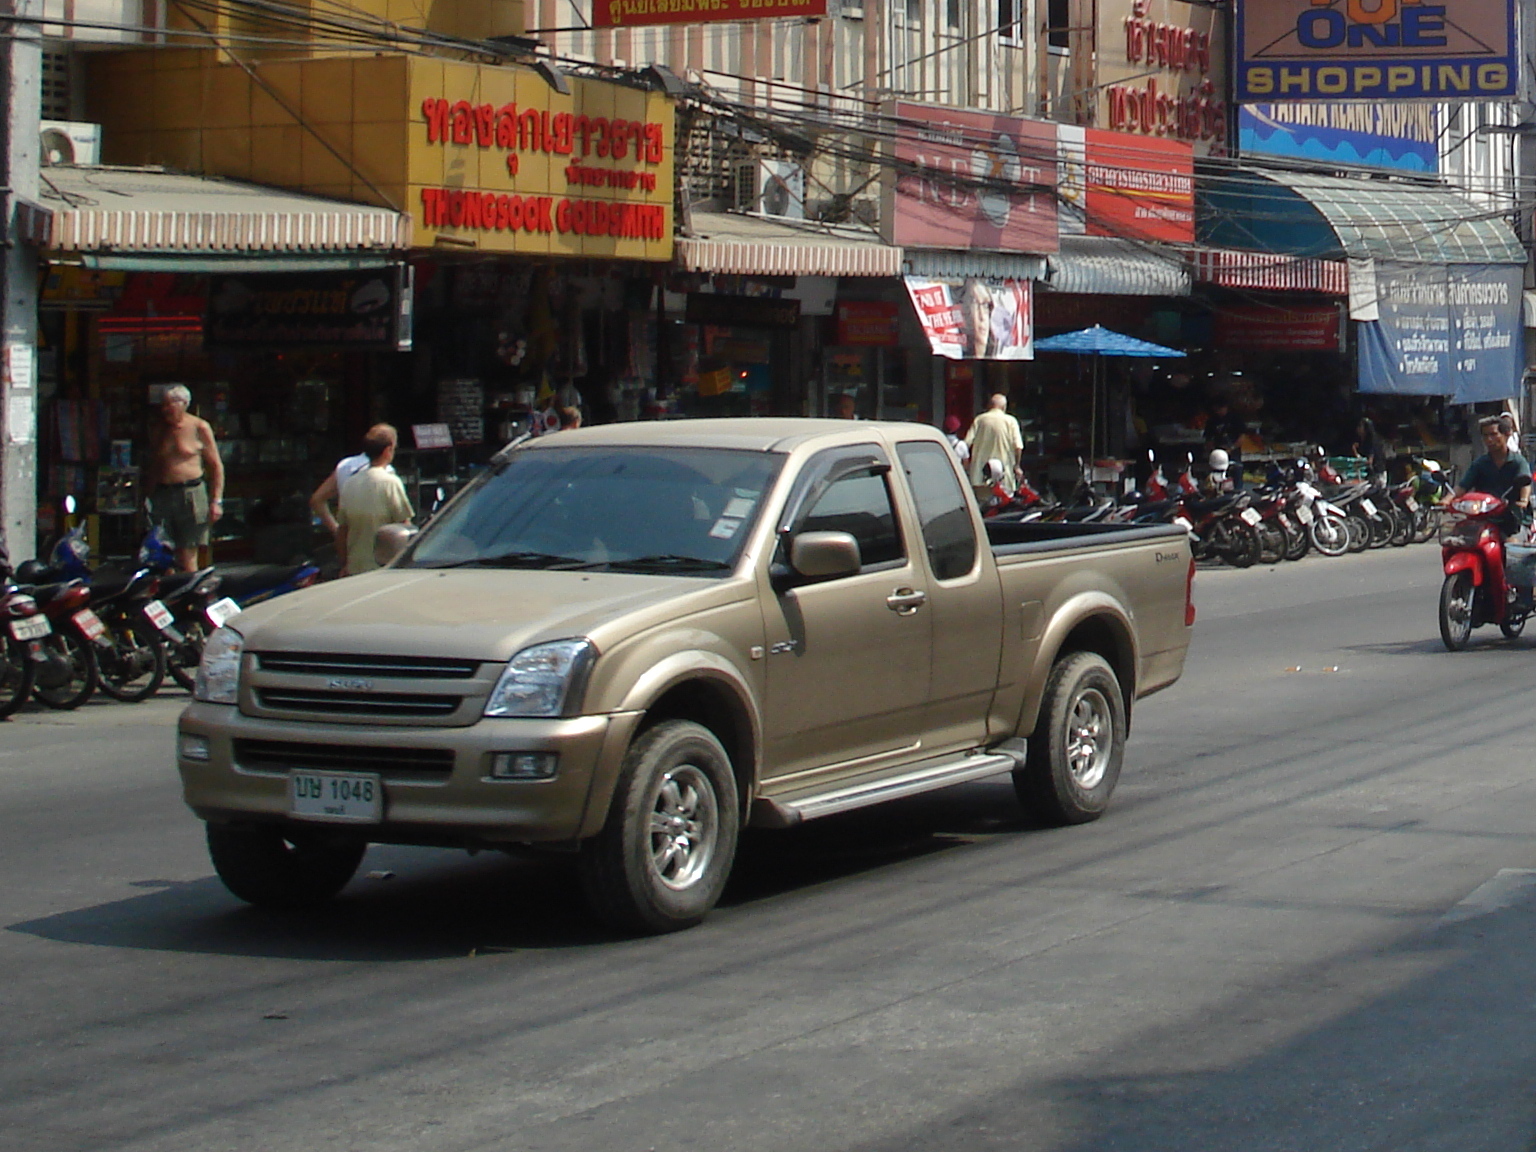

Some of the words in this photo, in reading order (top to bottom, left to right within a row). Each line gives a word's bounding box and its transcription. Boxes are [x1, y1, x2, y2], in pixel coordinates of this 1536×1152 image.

[1296, 6, 1448, 48] ONE
[1246, 62, 1509, 95] SHOPPING
[422, 97, 663, 176] ทองสุกเยาวราช
[421, 188, 554, 233] THONGSOOK
[556, 198, 665, 240] GOLDSMITH
